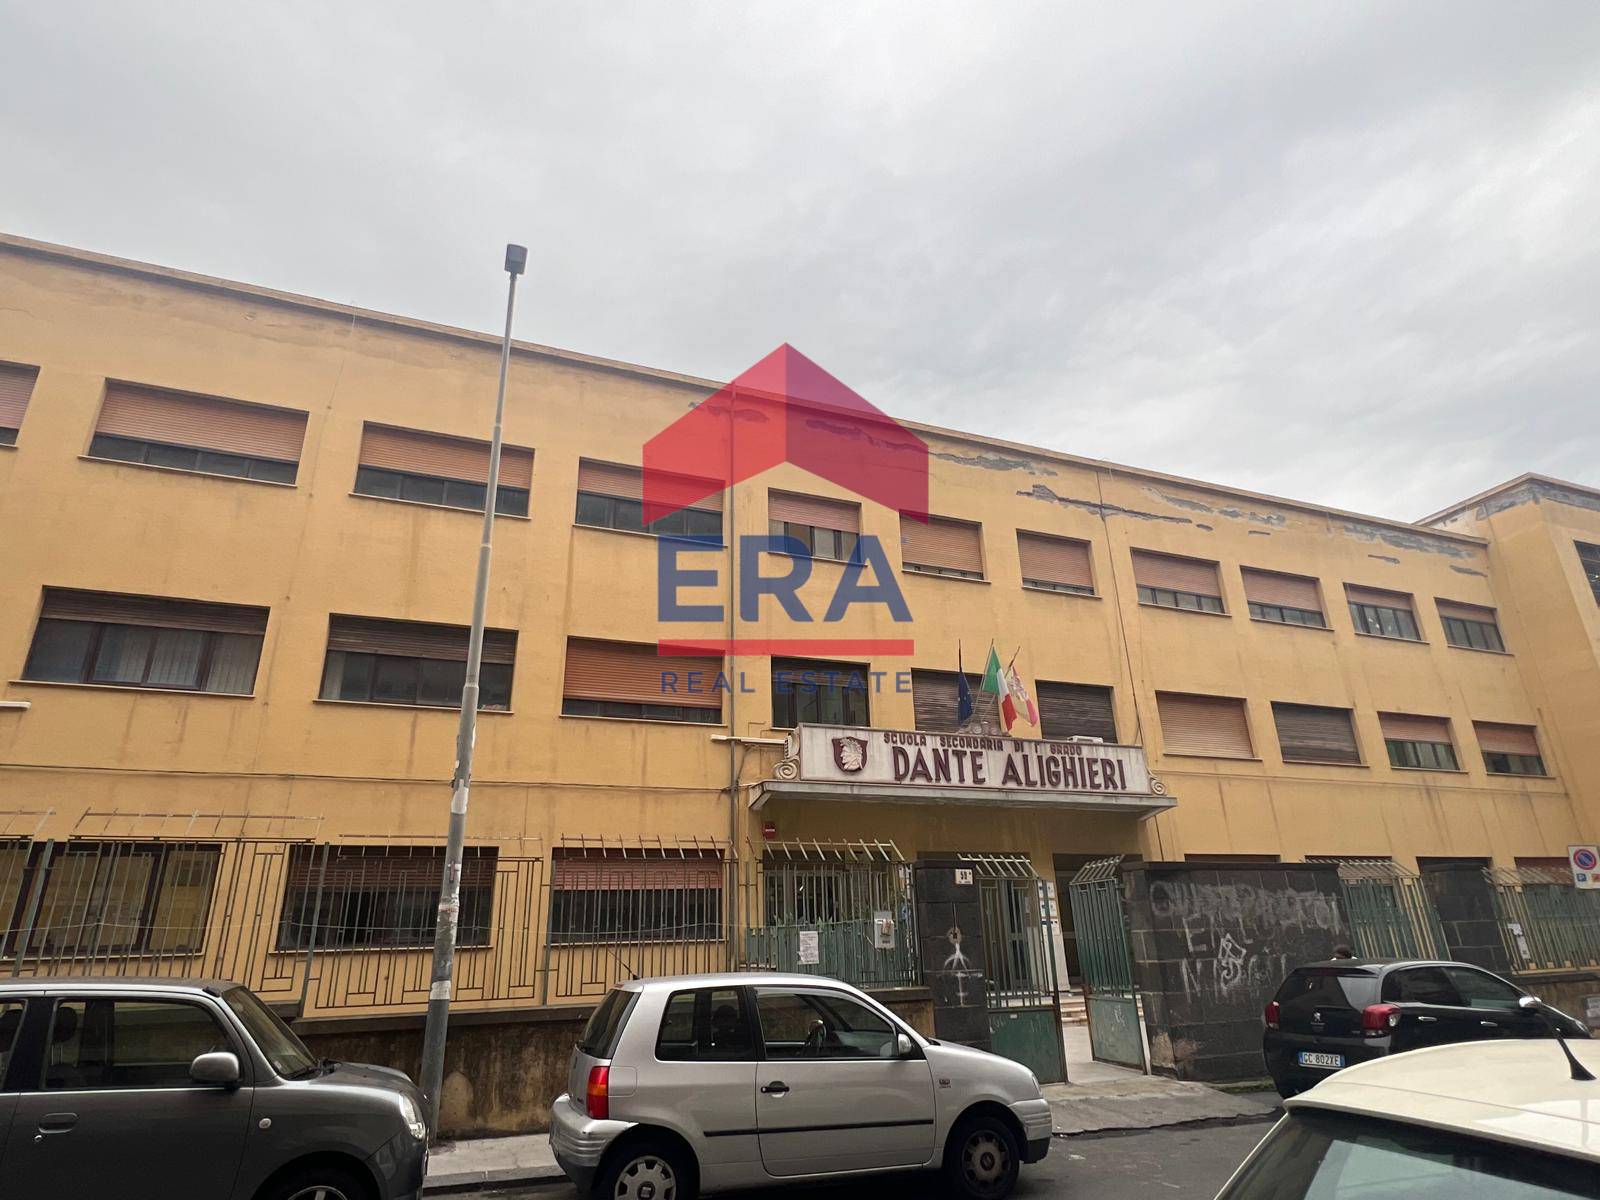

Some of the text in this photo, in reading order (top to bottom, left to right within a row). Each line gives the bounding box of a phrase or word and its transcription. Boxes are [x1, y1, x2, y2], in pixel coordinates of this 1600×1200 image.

[884, 732, 927, 747] SCUOLA
[940, 735, 1004, 752] SECONDARIA
[1014, 740, 1024, 753] DI
[1050, 743, 1082, 756] GRADO
[892, 746, 1127, 790] DANTE ALIGHIERI
